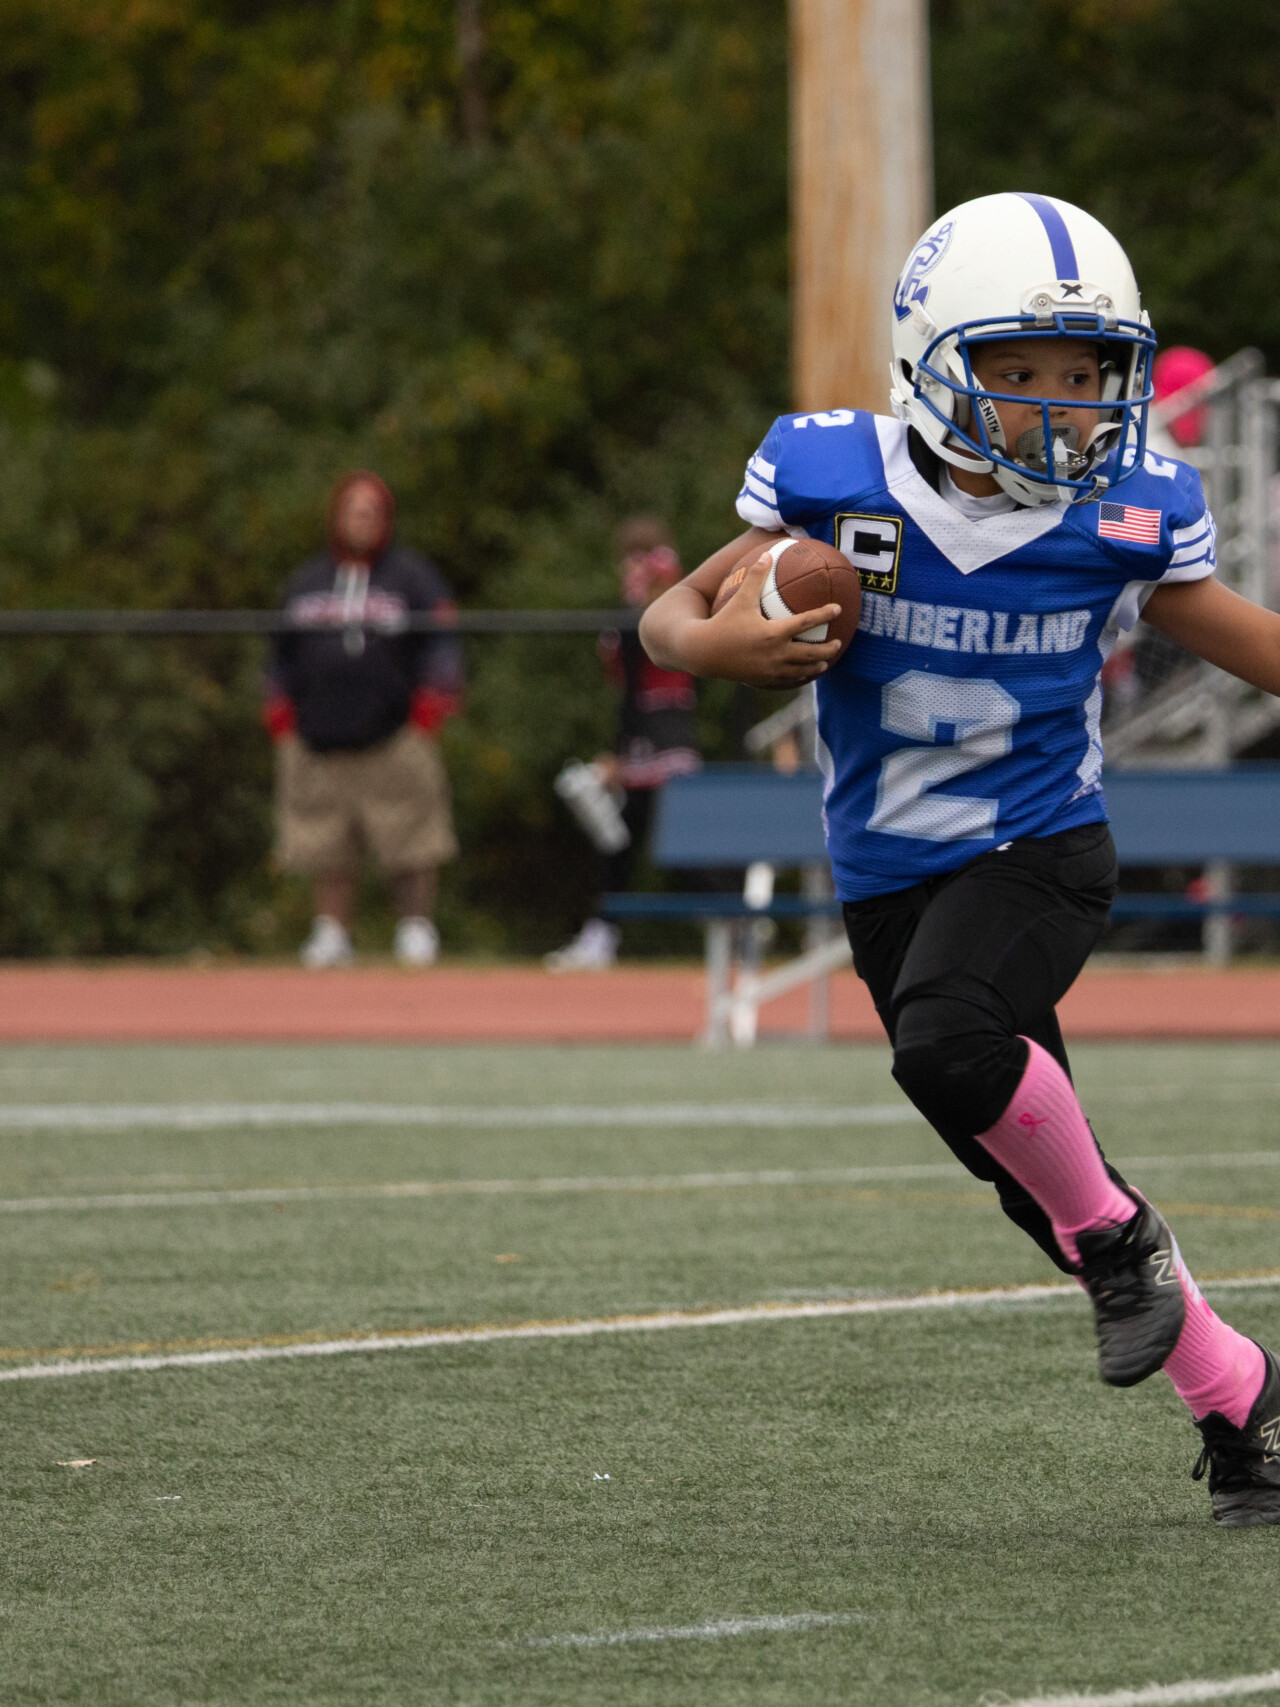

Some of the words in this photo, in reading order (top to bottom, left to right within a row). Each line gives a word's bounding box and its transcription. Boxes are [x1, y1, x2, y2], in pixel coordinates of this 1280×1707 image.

[975, 384, 1000, 434] ENITH
[840, 518, 898, 573] C
[856, 590, 1092, 655] UMBERLAND
[865, 669, 1021, 843] 2
